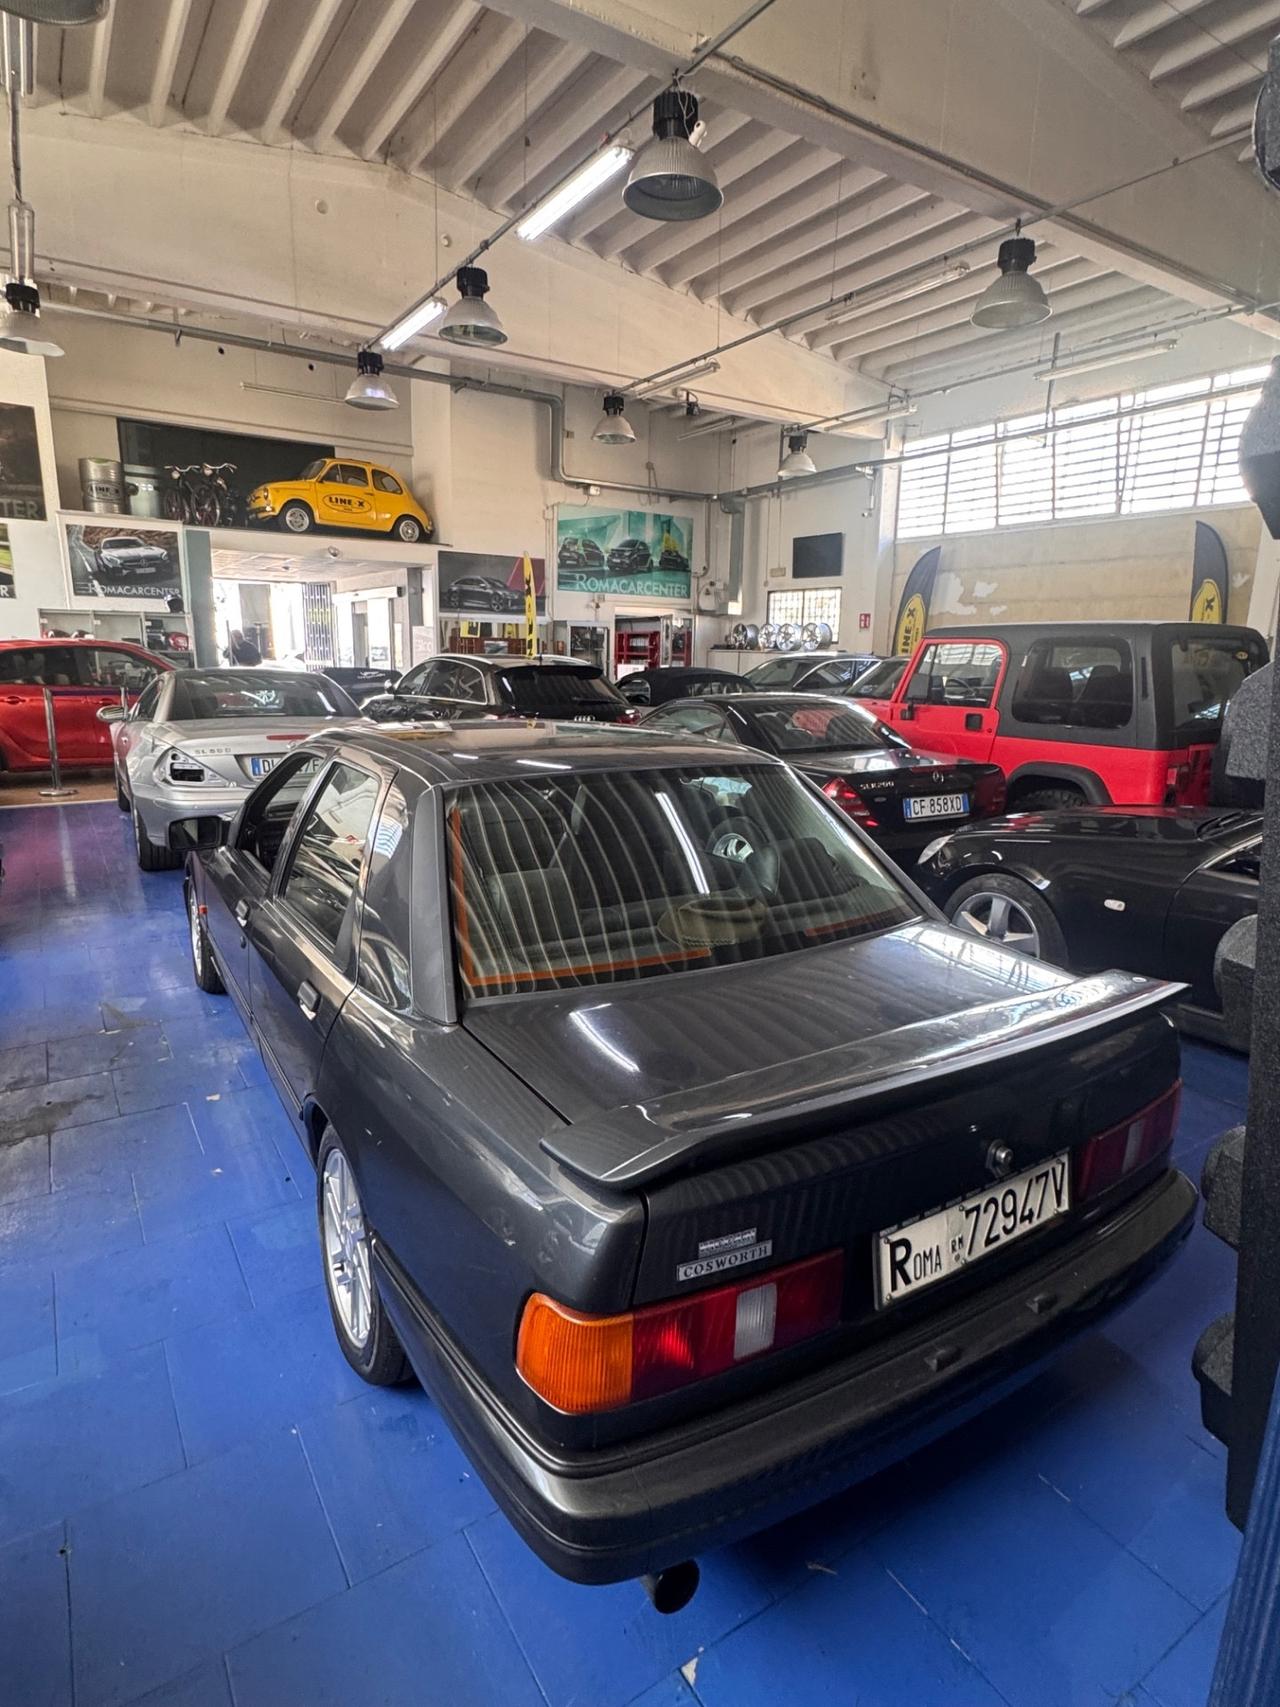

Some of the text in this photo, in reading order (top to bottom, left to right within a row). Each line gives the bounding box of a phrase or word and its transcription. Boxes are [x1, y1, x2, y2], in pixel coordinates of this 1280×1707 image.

[575, 573, 688, 598] ROMACARCENTER
[965, 1162, 1065, 1256] 72947V
[683, 1245, 768, 1278] COSWORTH
